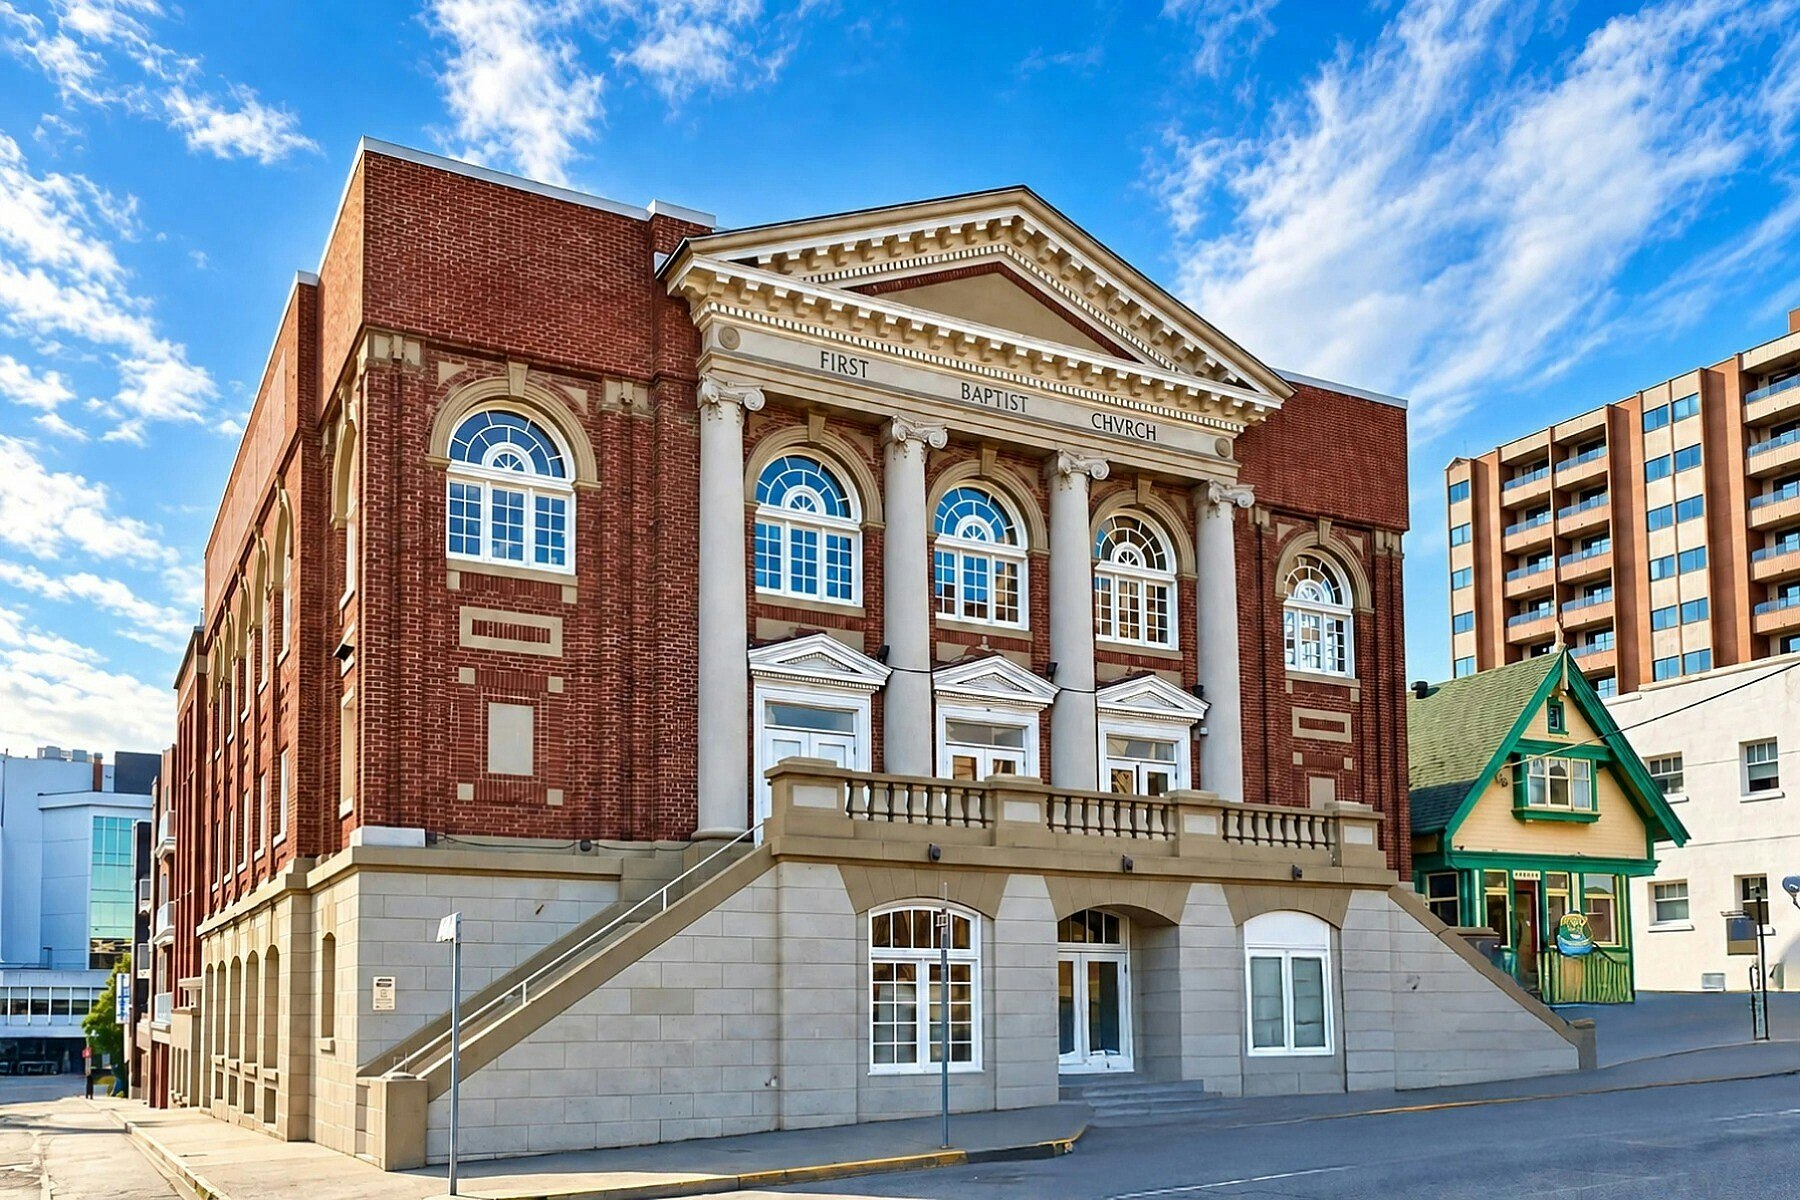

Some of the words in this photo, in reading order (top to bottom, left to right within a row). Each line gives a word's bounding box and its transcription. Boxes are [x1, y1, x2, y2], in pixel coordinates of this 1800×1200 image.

[820, 351, 869, 378] FIRST
[961, 382, 1029, 413] BAPTIST
[1091, 412, 1156, 441] CHVRCH
